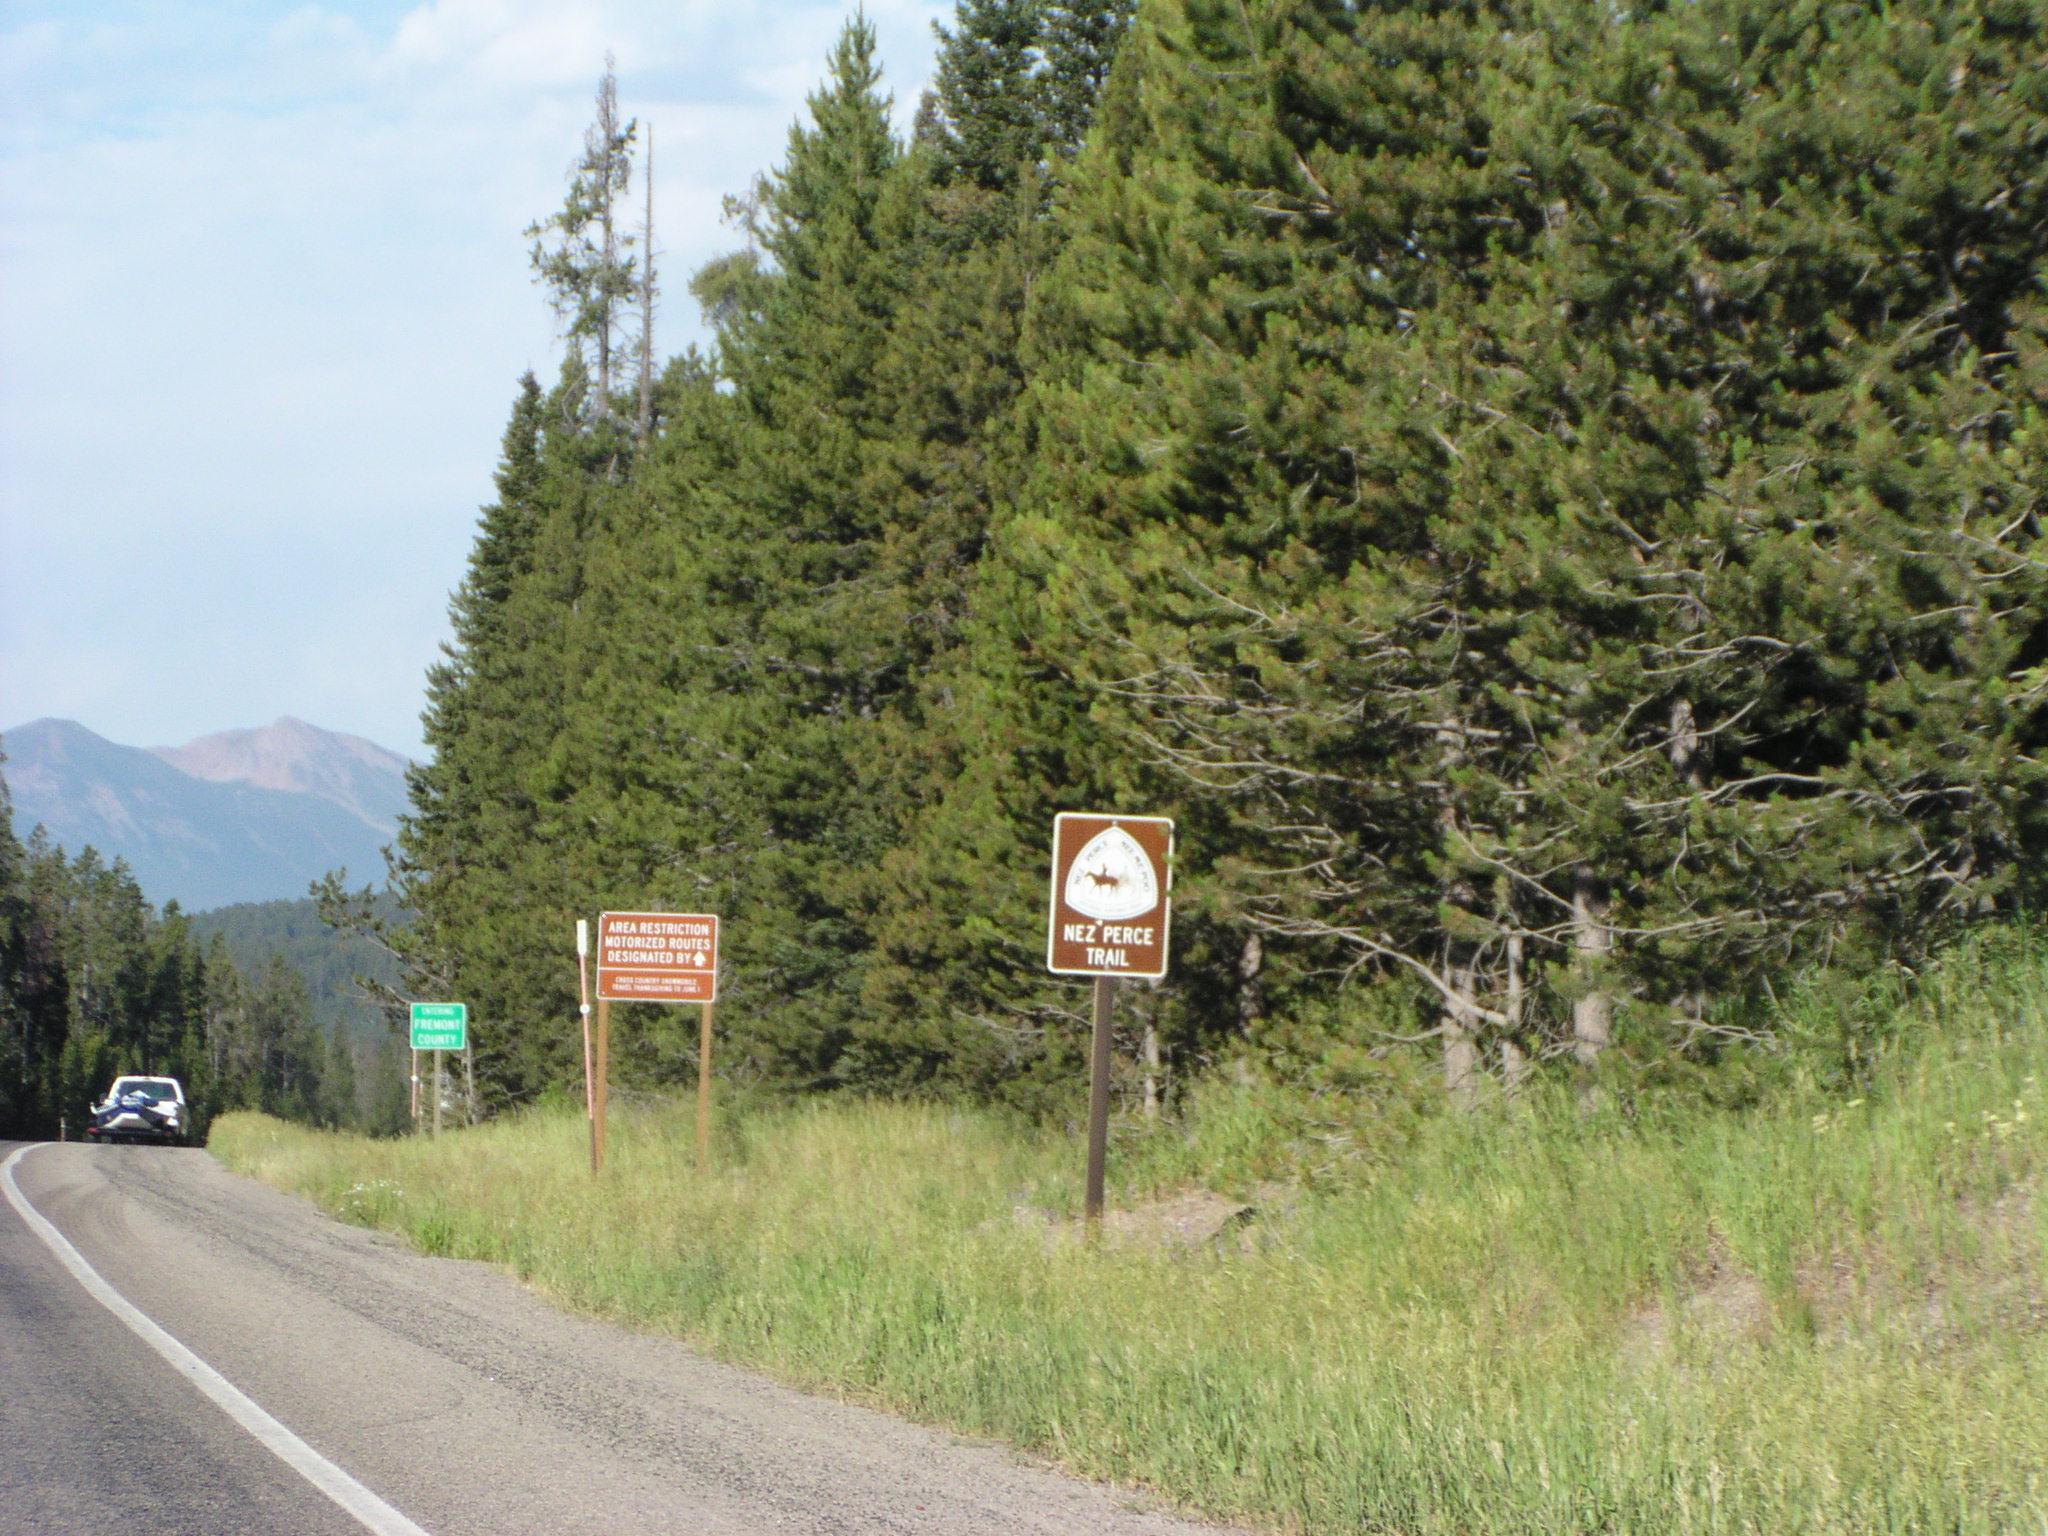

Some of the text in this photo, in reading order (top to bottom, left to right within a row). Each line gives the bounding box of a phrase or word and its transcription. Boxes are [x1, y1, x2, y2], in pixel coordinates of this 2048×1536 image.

[608, 921, 709, 936] AREA RESTRICTION
[1063, 924, 1154, 945] NEZ PERCE
[605, 936, 711, 951] MOTORIZED ROUTES
[607, 950, 691, 964] DESIGNATED BY
[1086, 947, 1130, 967] TRAIL
[414, 1018, 460, 1030] FREMONT
[417, 1033, 457, 1045] COUNTY
